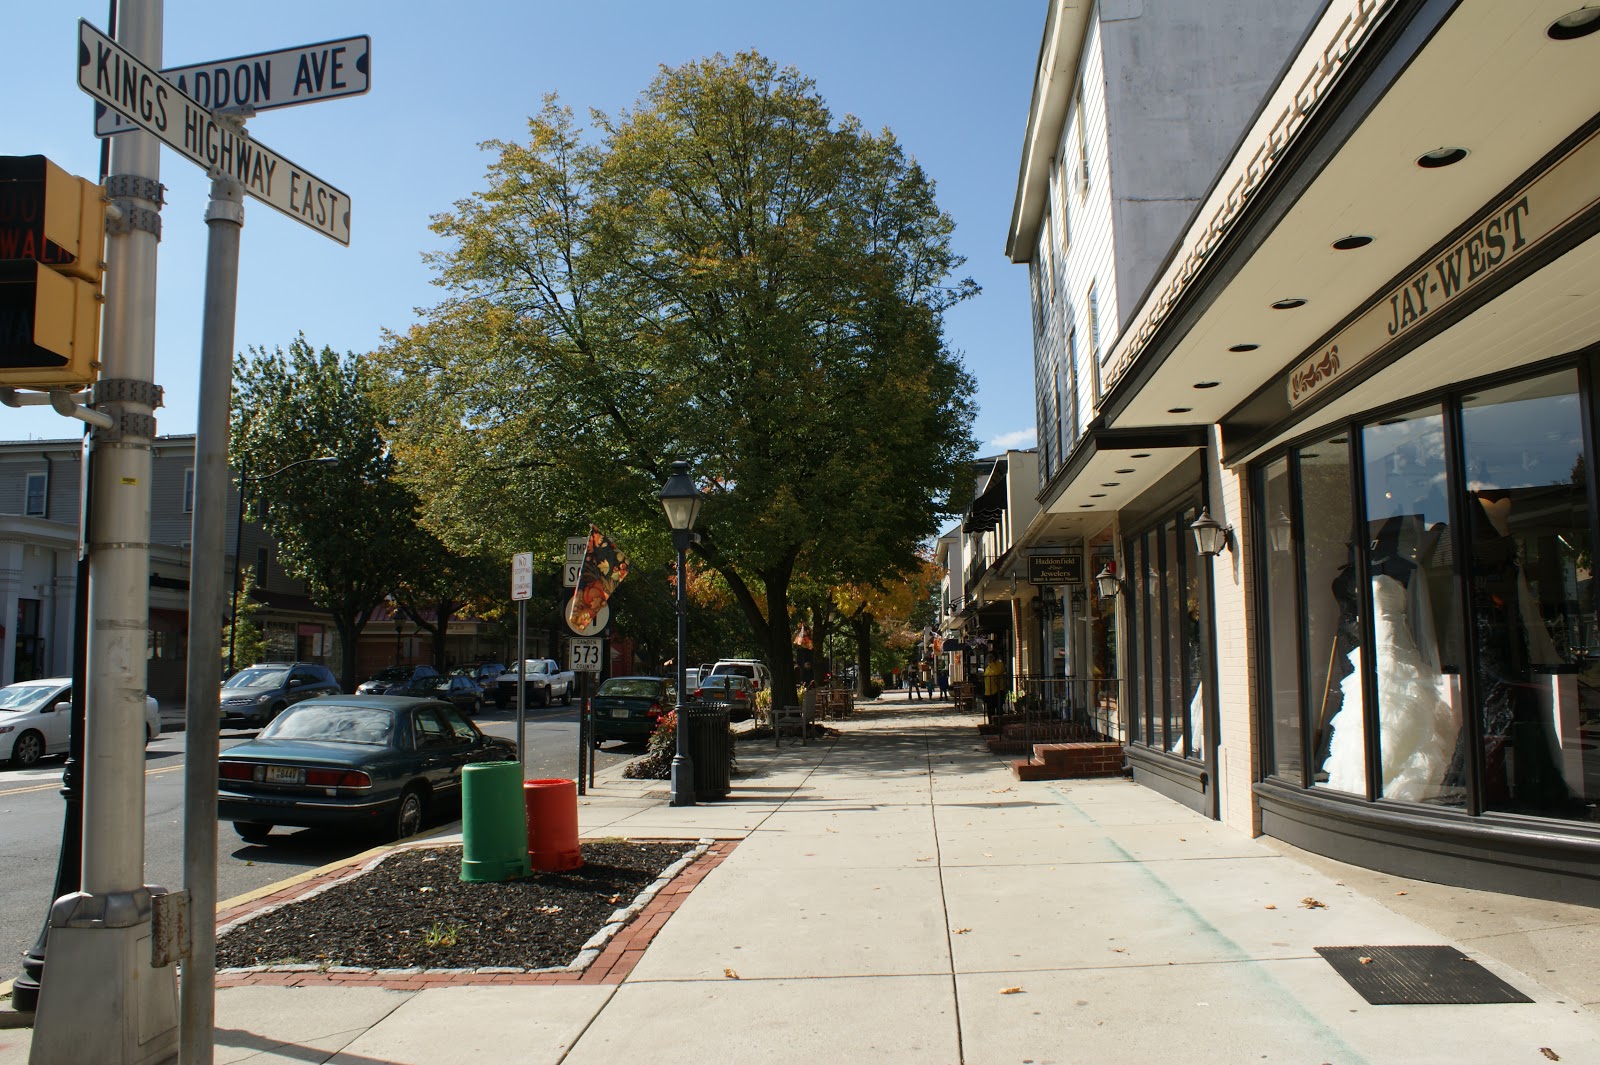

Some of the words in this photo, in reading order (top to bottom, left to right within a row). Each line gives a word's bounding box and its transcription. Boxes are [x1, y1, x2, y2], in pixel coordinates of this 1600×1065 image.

[164, 60, 271, 110] DDON
[293, 47, 347, 97] AVE
[97, 40, 168, 132] KINGS
[184, 104, 277, 197] HIGHWAY
[289, 170, 338, 232] EAST
[1387, 195, 1529, 336] JAY-WEST
[518, 557, 527, 567] NO
[573, 646, 599, 664] 573
